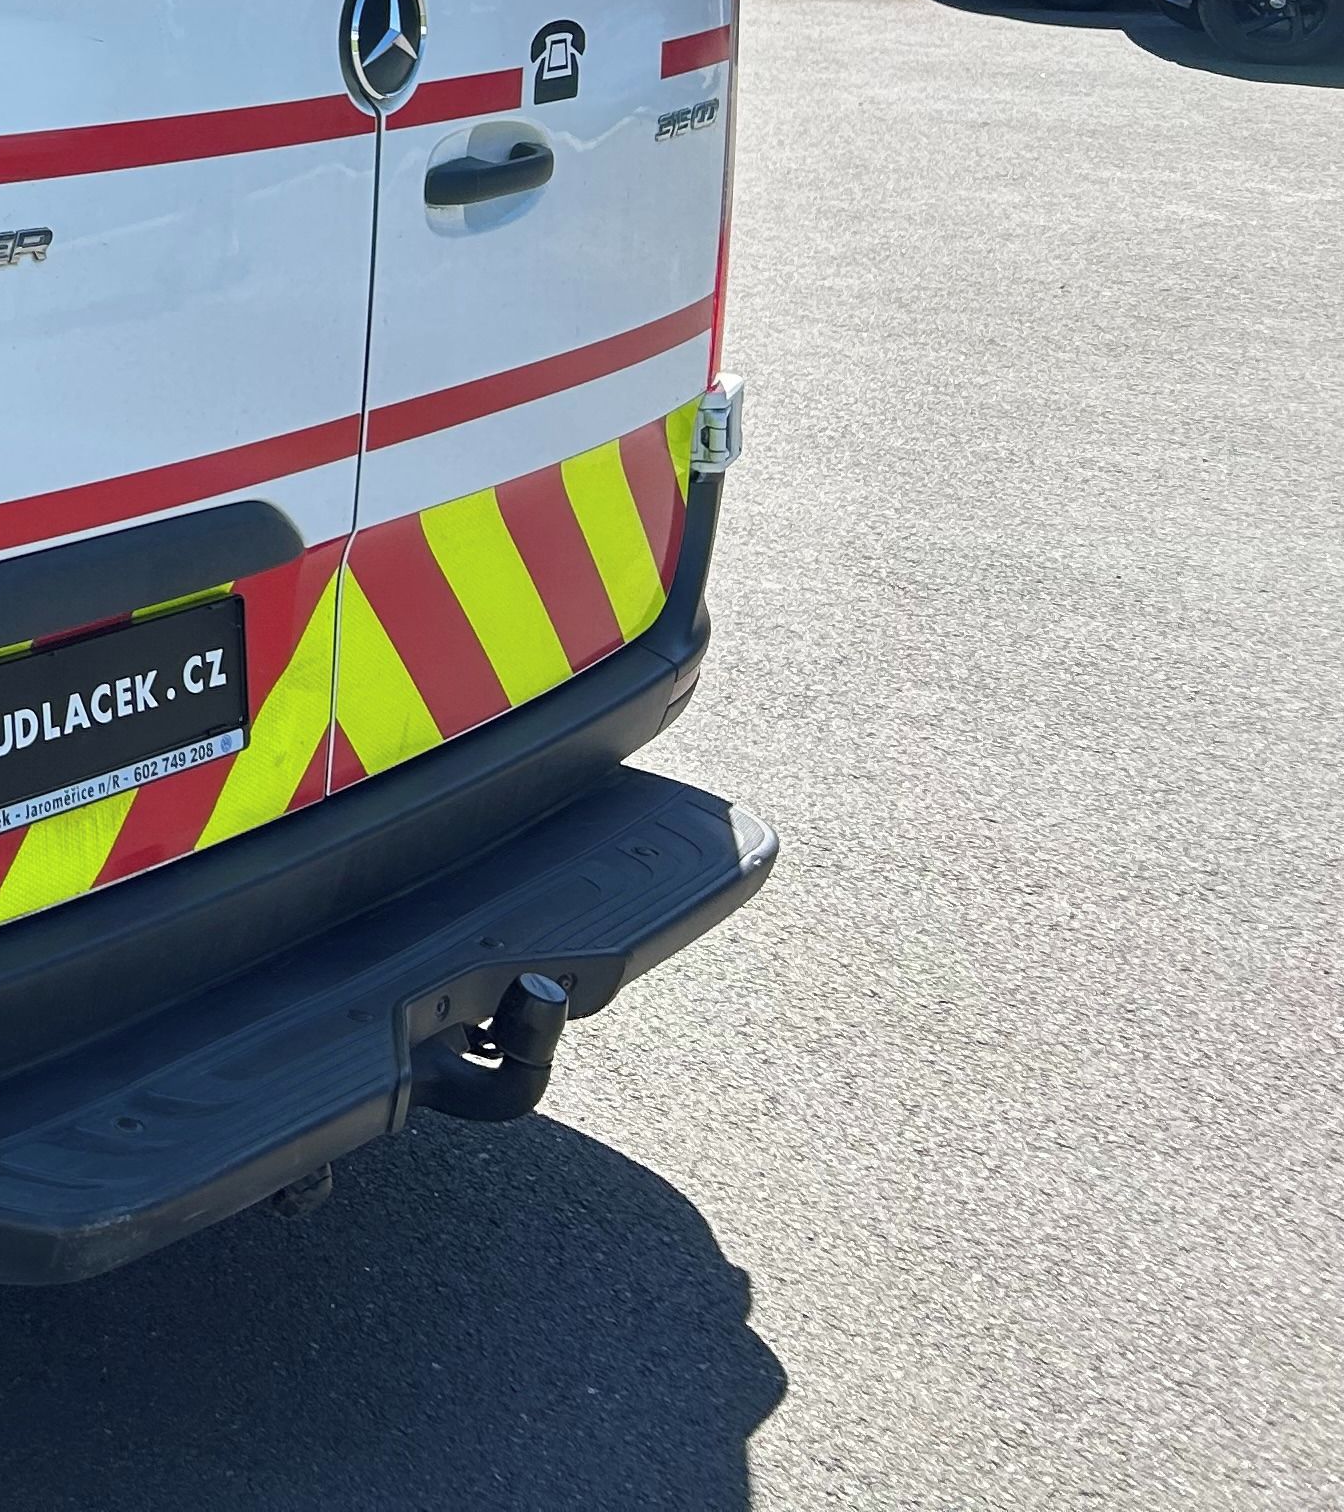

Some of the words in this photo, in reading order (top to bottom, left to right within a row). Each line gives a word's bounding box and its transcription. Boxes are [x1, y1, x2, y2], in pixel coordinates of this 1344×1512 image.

[24, 784, 95, 820] Jaroměřice
[98, 774, 121, 797] n/R
[133, 760, 159, 783] 602
[162, 751, 187, 773] 749
[190, 742, 214, 763] 208
